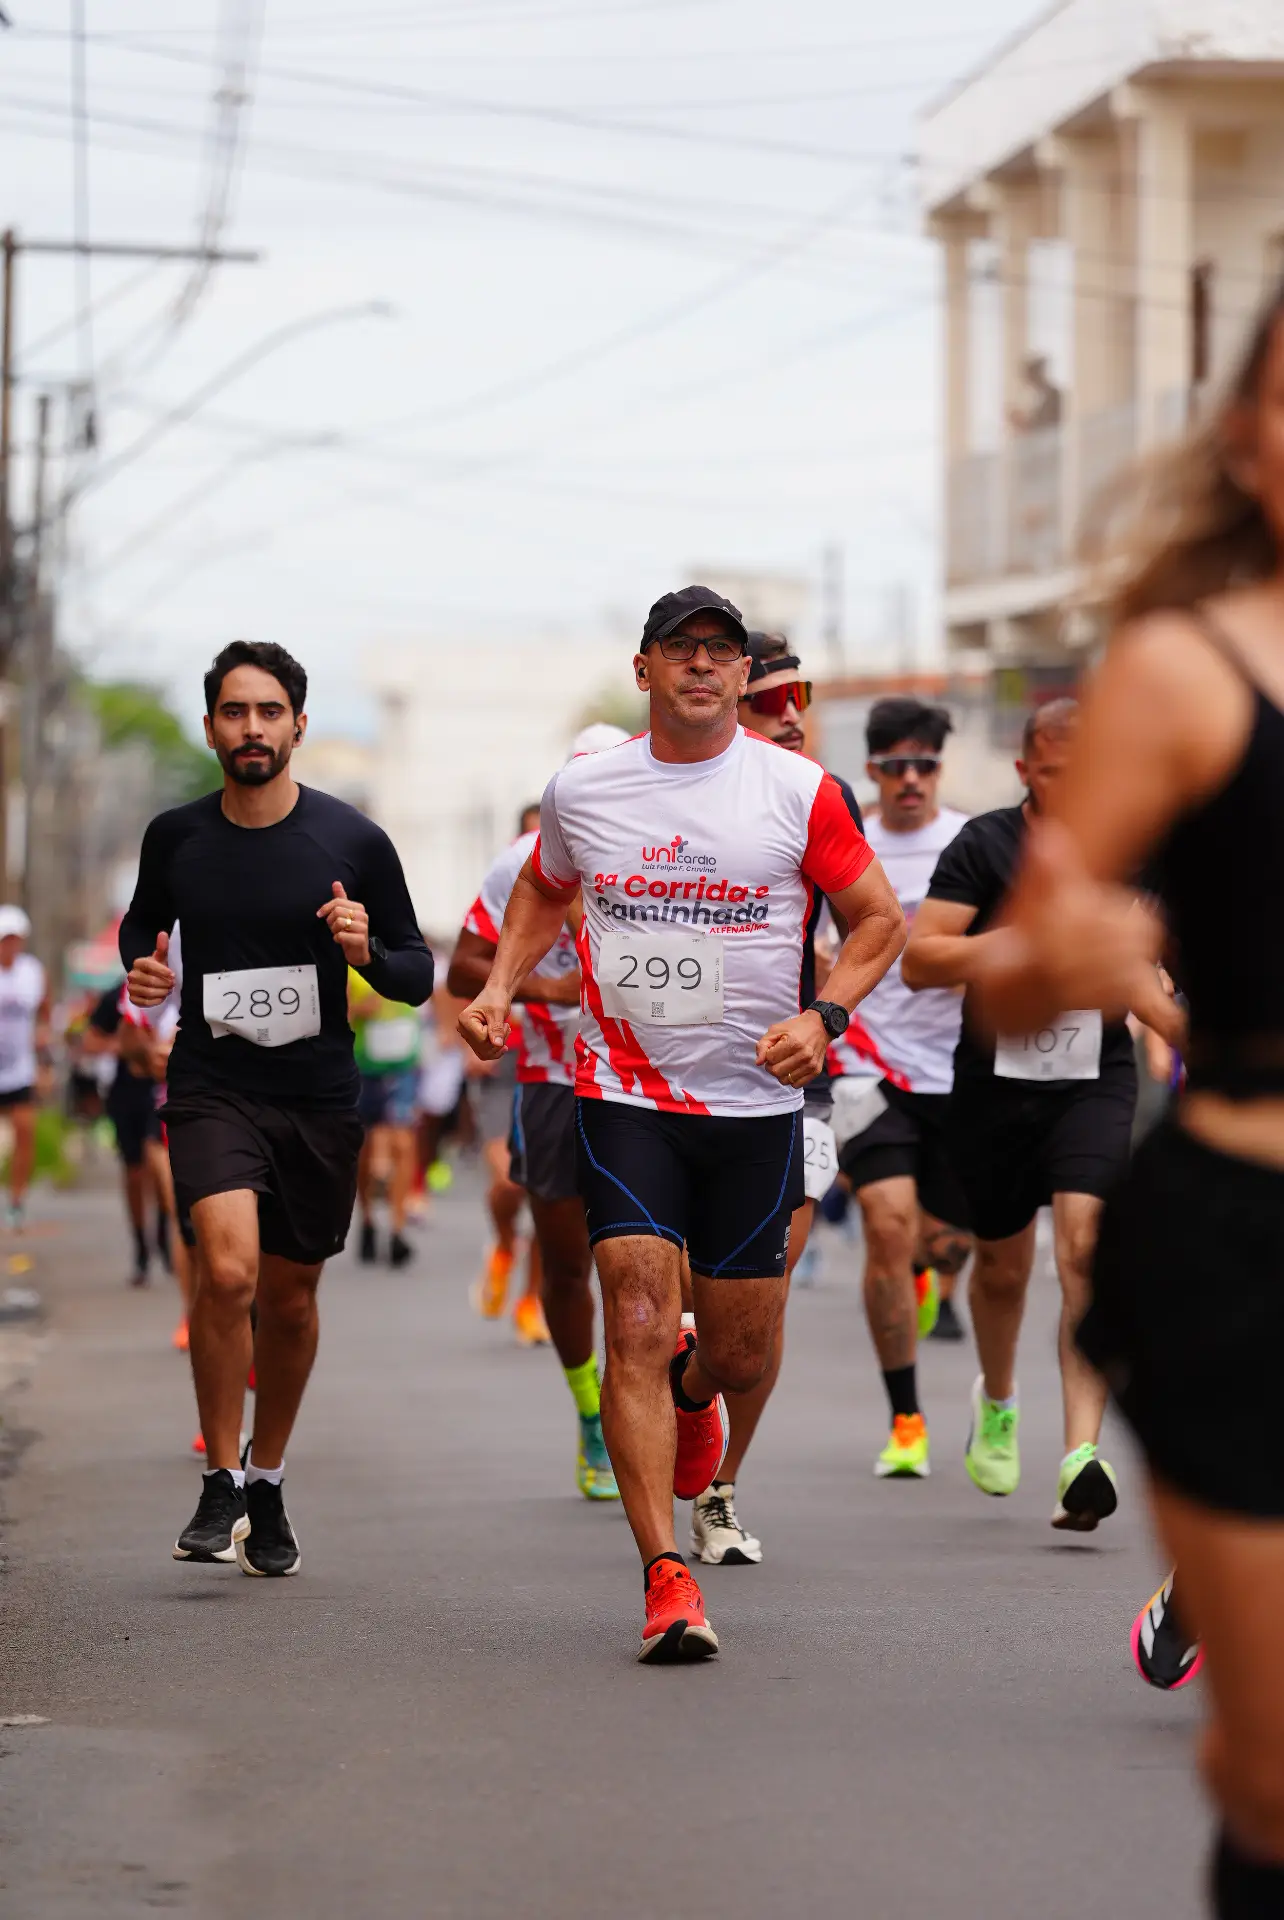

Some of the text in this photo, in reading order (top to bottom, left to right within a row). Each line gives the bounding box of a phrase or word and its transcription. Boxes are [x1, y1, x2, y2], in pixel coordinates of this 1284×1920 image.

[657, 864, 678, 873] Felipe
[686, 866, 717, 874] Cruvinel
[624, 874, 749, 903] Corrida
[755, 885, 770, 899] e
[597, 897, 769, 924] Caminhada
[616, 955, 702, 990] 299
[222, 987, 300, 1020] 289
[1023, 1027, 1081, 1054] 107
